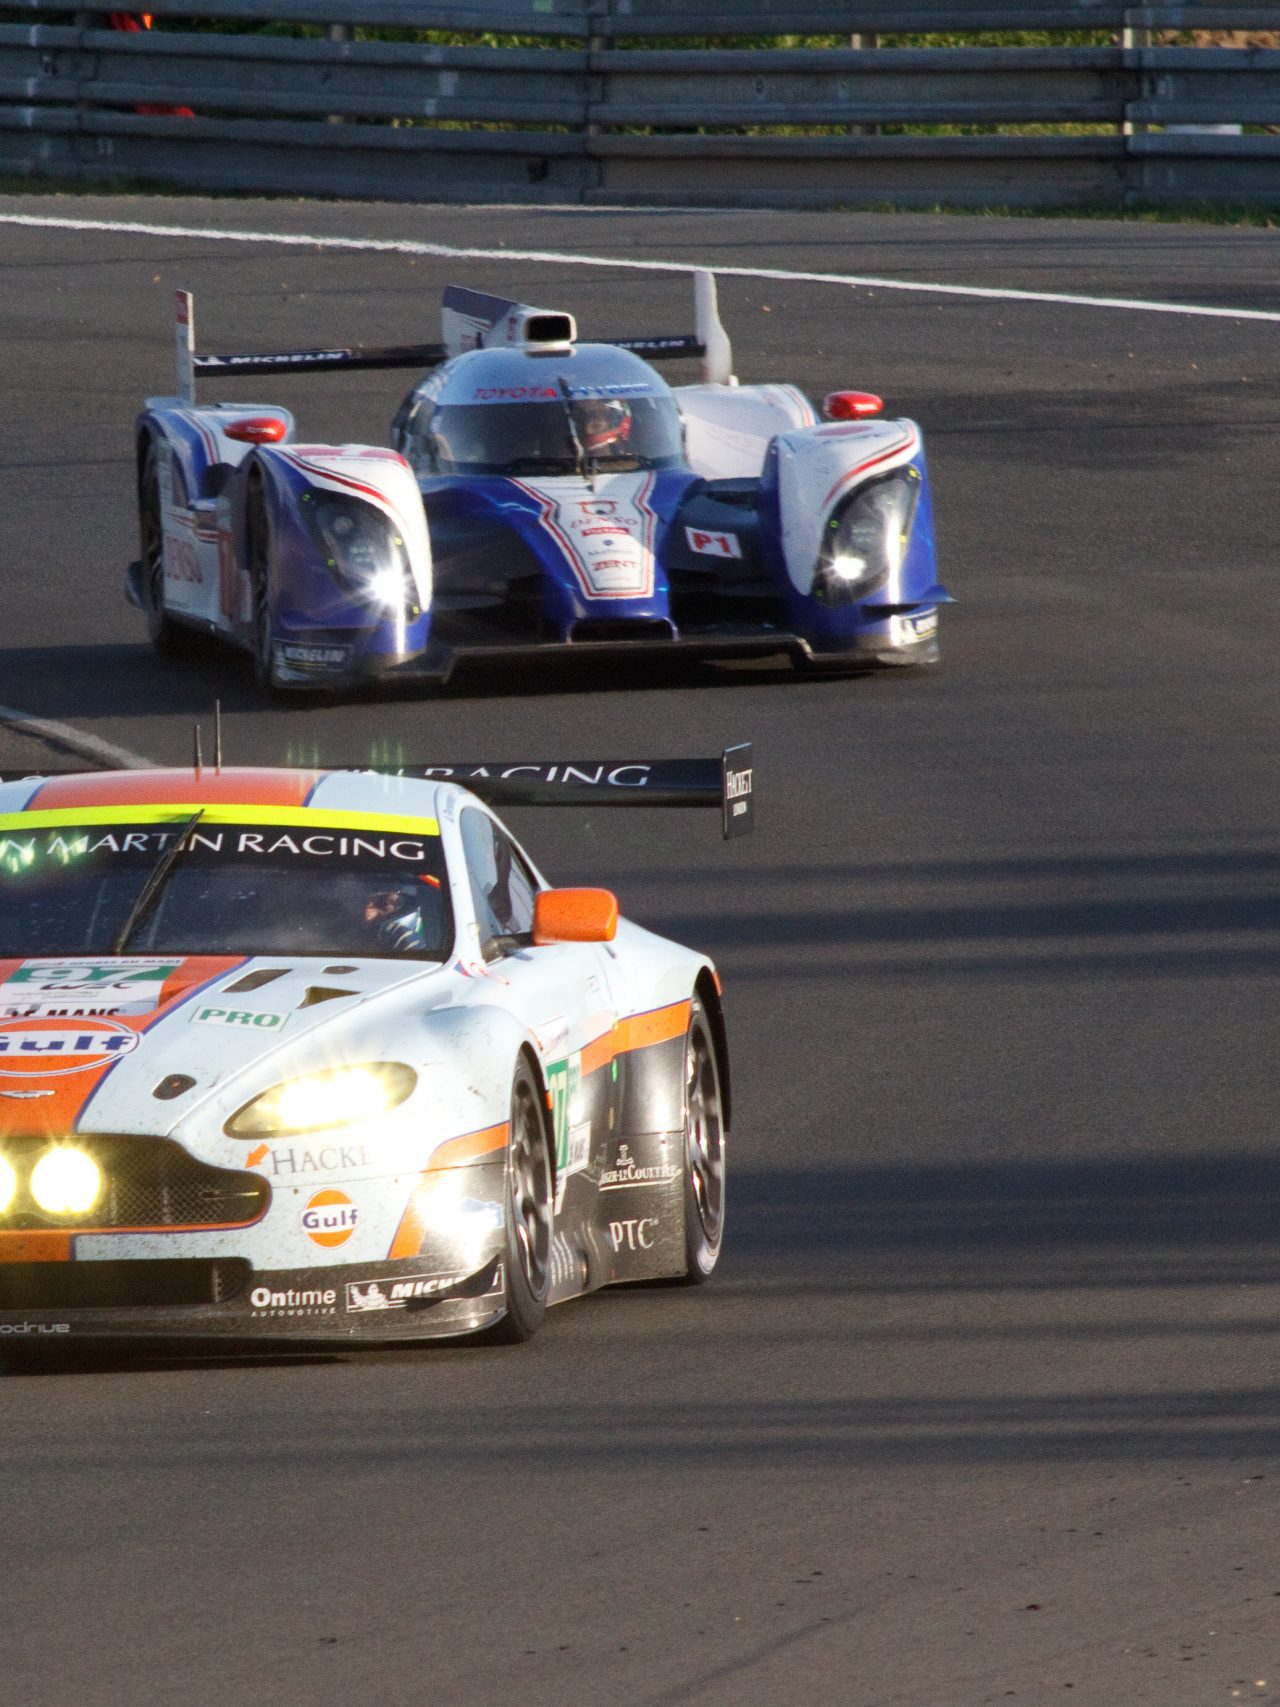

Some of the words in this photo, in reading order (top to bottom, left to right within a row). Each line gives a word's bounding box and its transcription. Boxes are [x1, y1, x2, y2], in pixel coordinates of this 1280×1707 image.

[229, 351, 345, 365] MICHELIN
[473, 386, 558, 400] TOYOTA
[691, 532, 731, 553] P1
[237, 833, 425, 861] RACING
[28, 965, 161, 983] 97
[198, 1008, 281, 1028] PRO
[302, 1208, 358, 1229] Gulf
[609, 1218, 654, 1252] PTC
[250, 1286, 337, 1307] Ontime
[250, 1306, 338, 1317] AUTOMOTIVE
